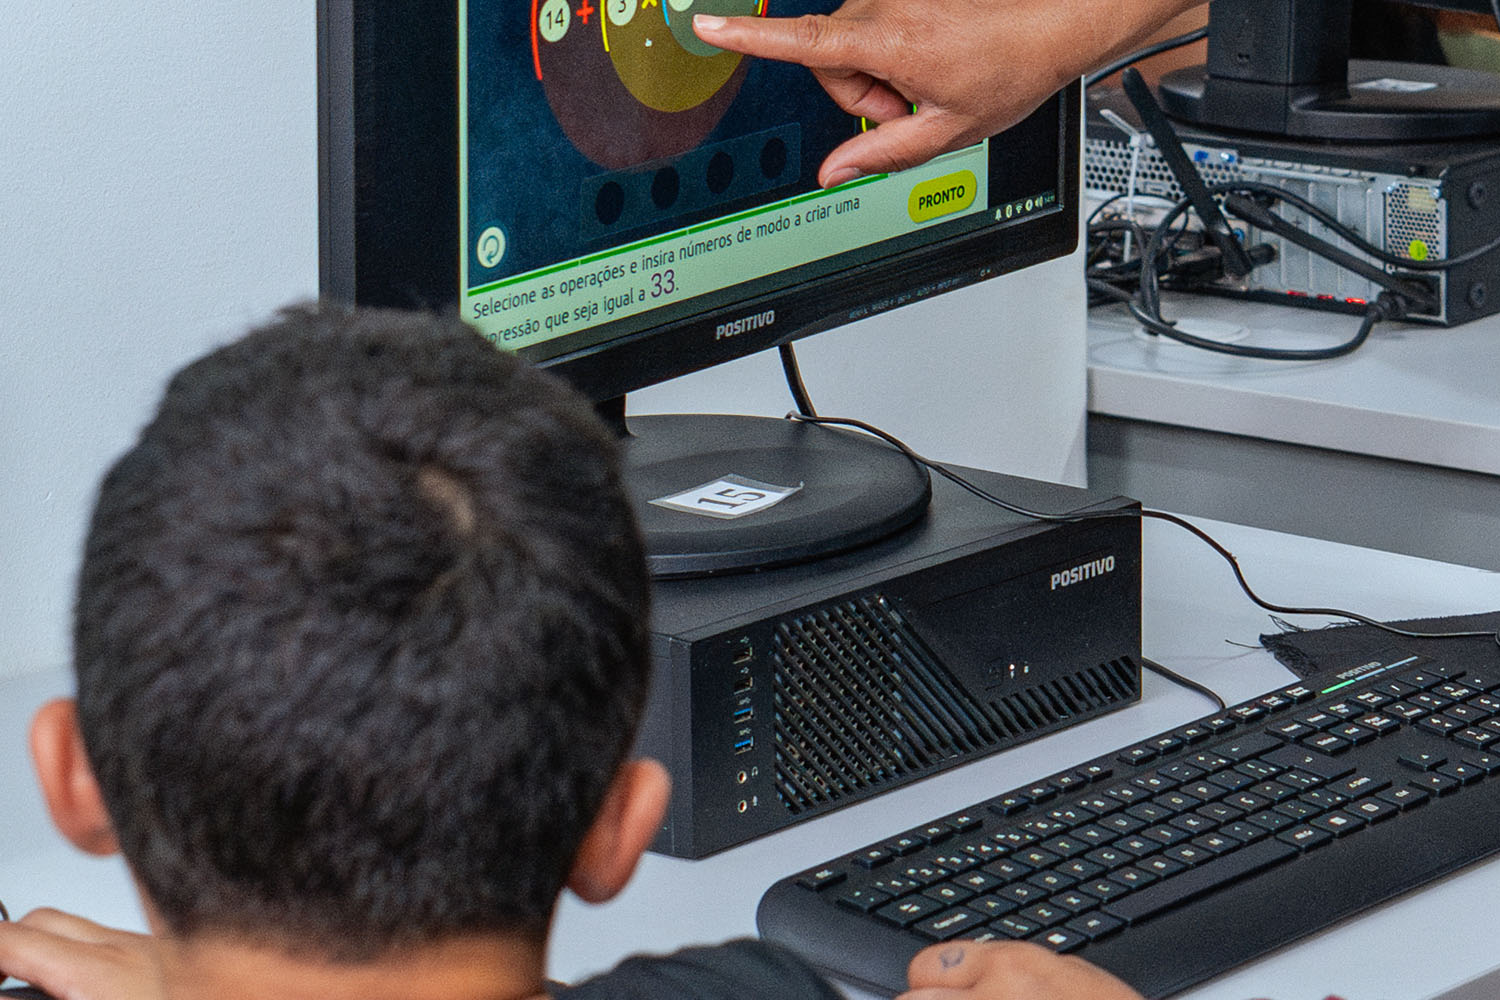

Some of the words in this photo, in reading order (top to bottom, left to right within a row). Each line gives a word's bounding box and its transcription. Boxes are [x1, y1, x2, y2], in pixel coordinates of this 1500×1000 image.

[546, 8, 564, 30] 14
[918, 185, 966, 210] PRONTO
[474, 290, 537, 319] Selecione
[541, 285, 555, 300] as
[559, 263, 625, 295] operações
[630, 262, 638, 274] e
[642, 250, 675, 271] insira
[679, 234, 733, 261] números
[737, 226, 752, 243] de
[757, 215, 790, 238] modo
[794, 213, 801, 226] a
[805, 204, 832, 224] criar
[835, 197, 861, 215] uma
[545, 311, 570, 332] que
[573, 302, 599, 322] seja
[603, 287, 634, 315] igual
[638, 289, 645, 301] a
[650, 268, 679, 299] 33.
[715, 310, 775, 340] POSITIVO
[697, 488, 766, 509] 15
[1051, 555, 1115, 590] POSITIVO
